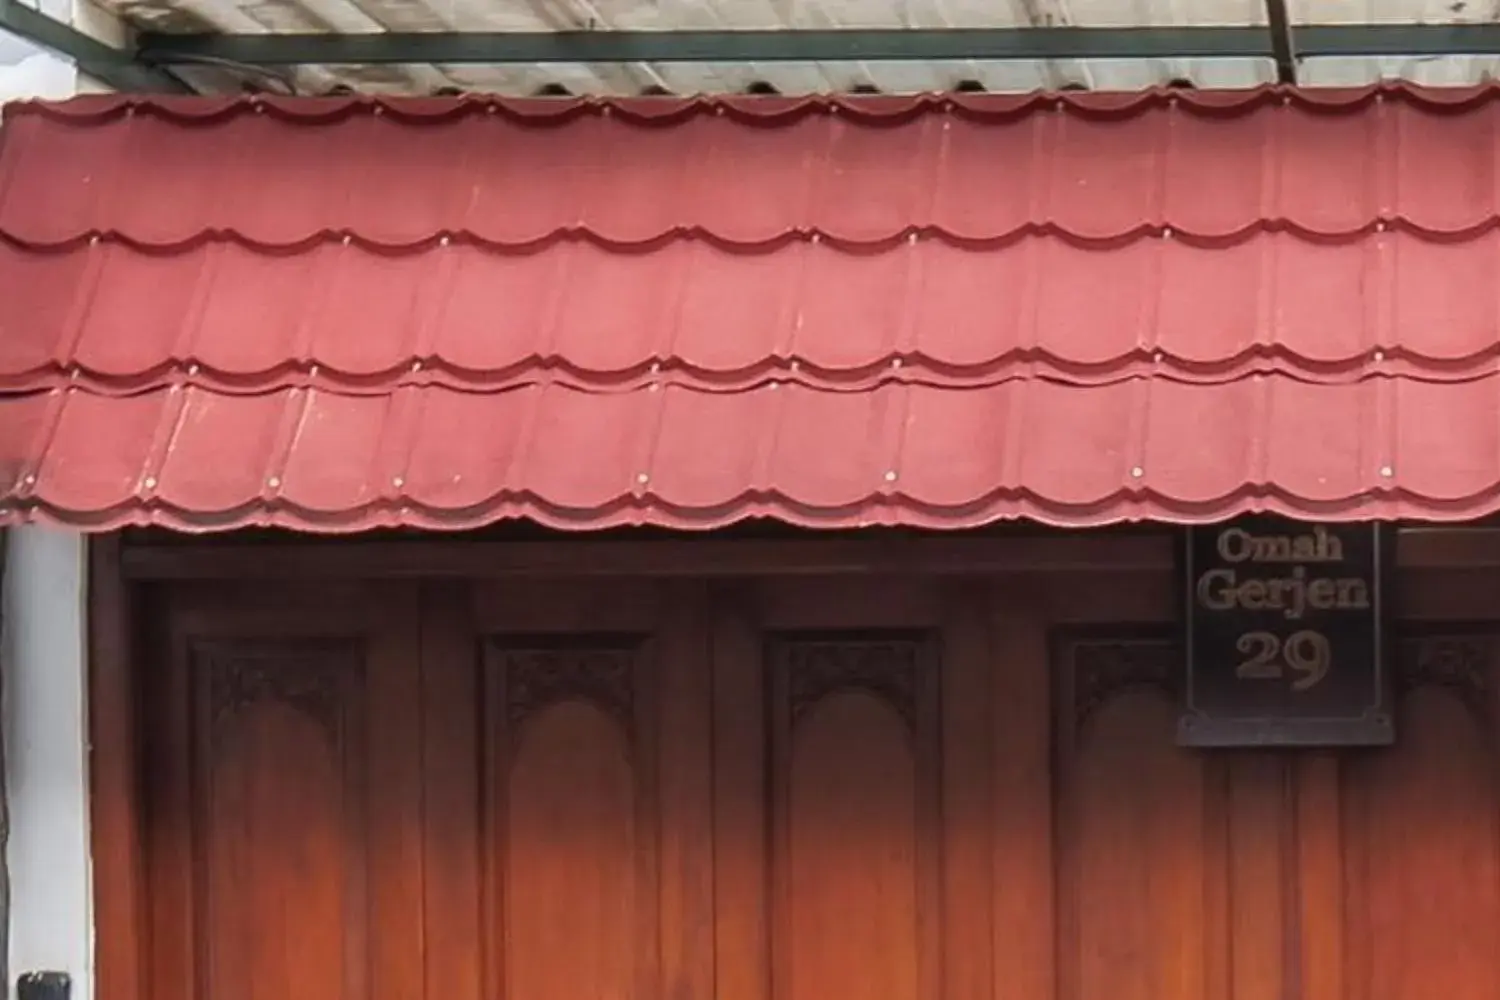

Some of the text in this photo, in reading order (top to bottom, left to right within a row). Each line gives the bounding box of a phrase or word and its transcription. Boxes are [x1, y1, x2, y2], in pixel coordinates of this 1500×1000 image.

[1217, 524, 1344, 562] Omah
[1197, 566, 1370, 619] Gerjen
[1236, 630, 1331, 691] 29
